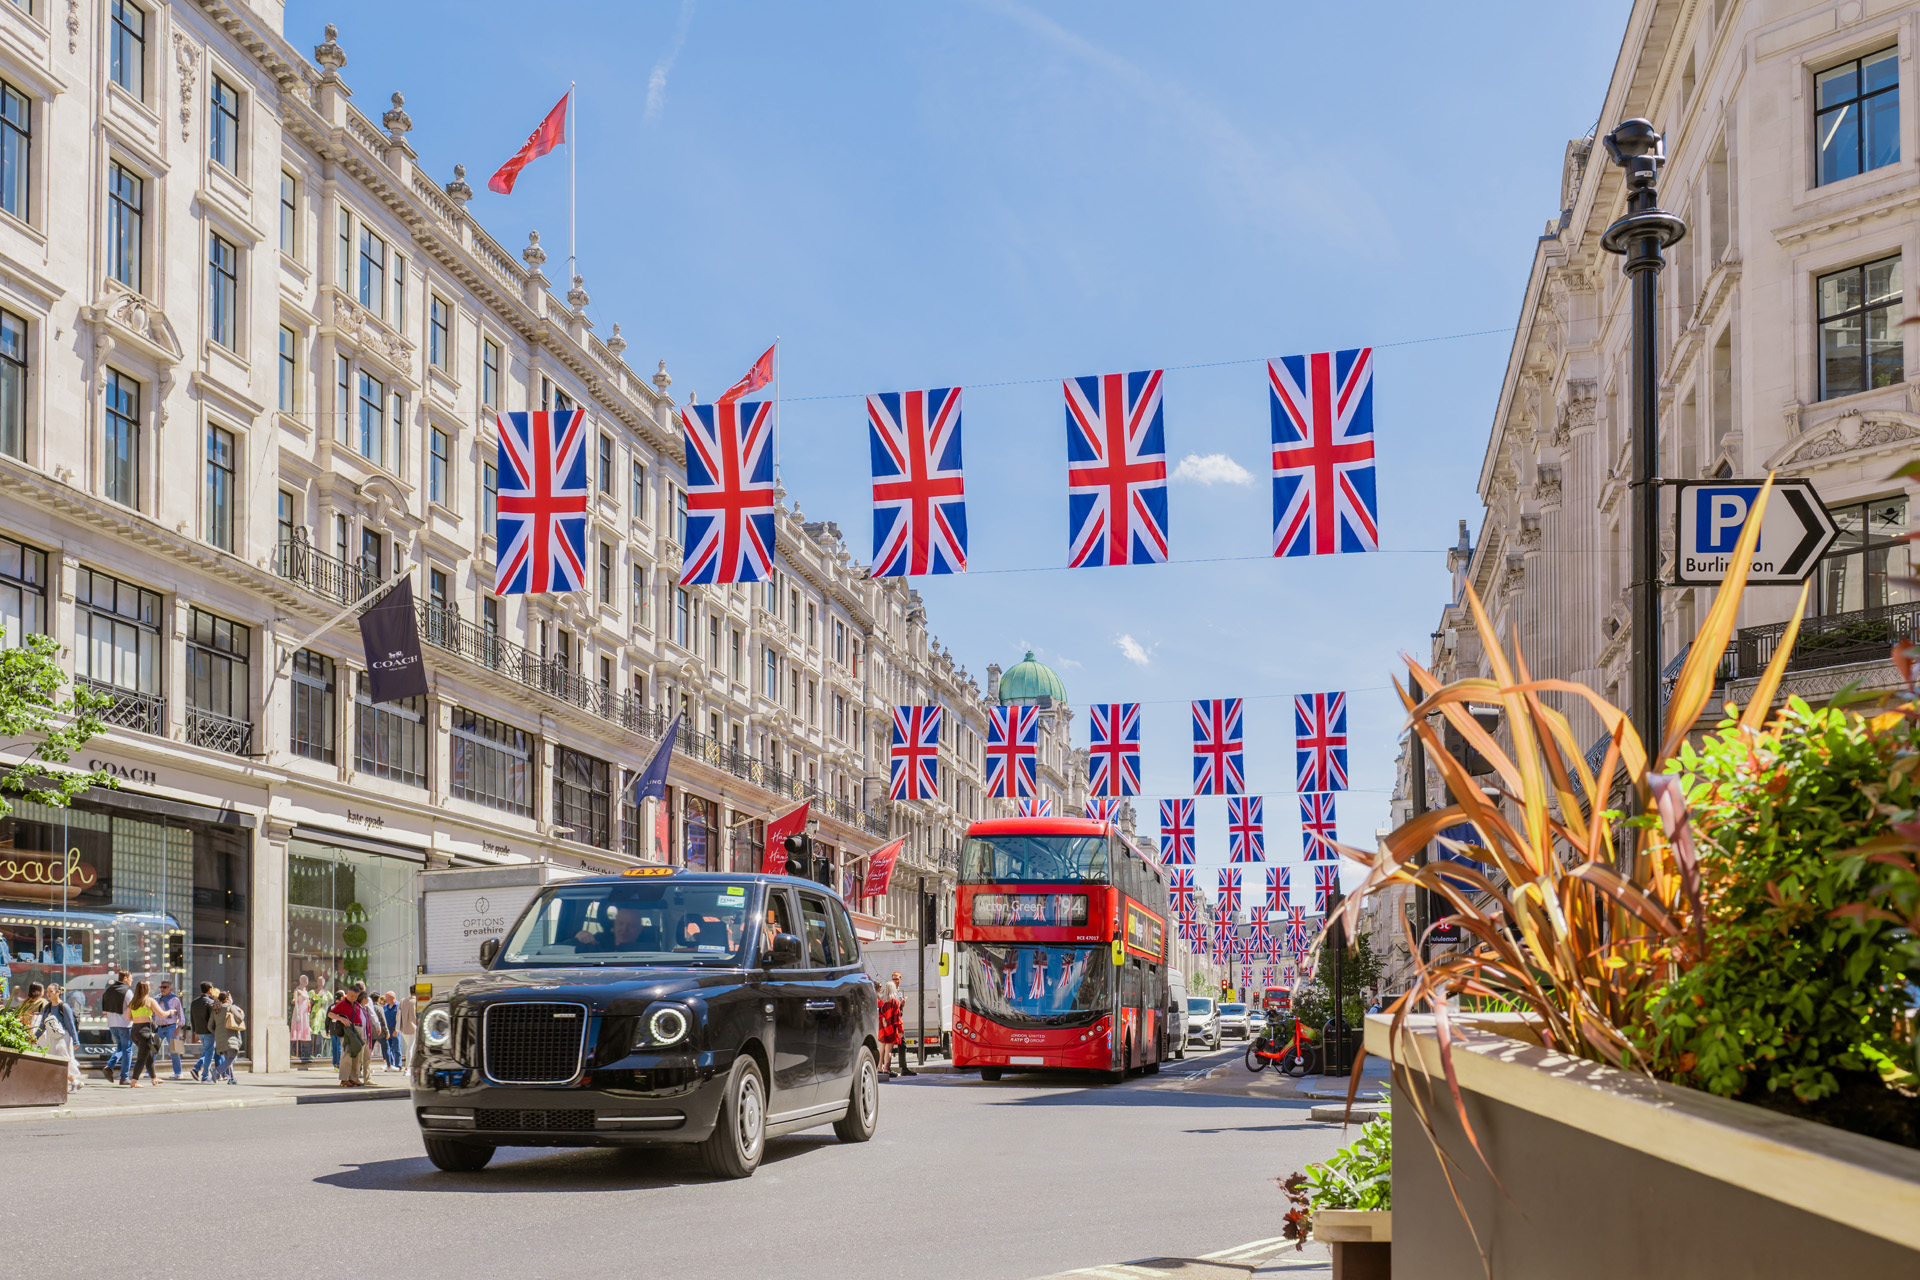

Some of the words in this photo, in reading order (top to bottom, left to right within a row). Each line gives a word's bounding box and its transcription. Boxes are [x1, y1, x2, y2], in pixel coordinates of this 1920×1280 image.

[1711, 495, 1747, 546] P
[1686, 556, 1773, 572] Burlion
[372, 655, 418, 669] COACH
[89, 759, 157, 784] COACH
[347, 809, 364, 822] kate
[364, 816, 385, 829] spade
[0, 848, 94, 886] oach
[628, 868, 669, 876] TAXI
[979, 901, 1009, 912] Acton
[1012, 901, 1044, 912] Green
[1062, 898, 1083, 915] 94
[463, 917, 504, 927] OPTIONS
[464, 927, 504, 937] greathire
